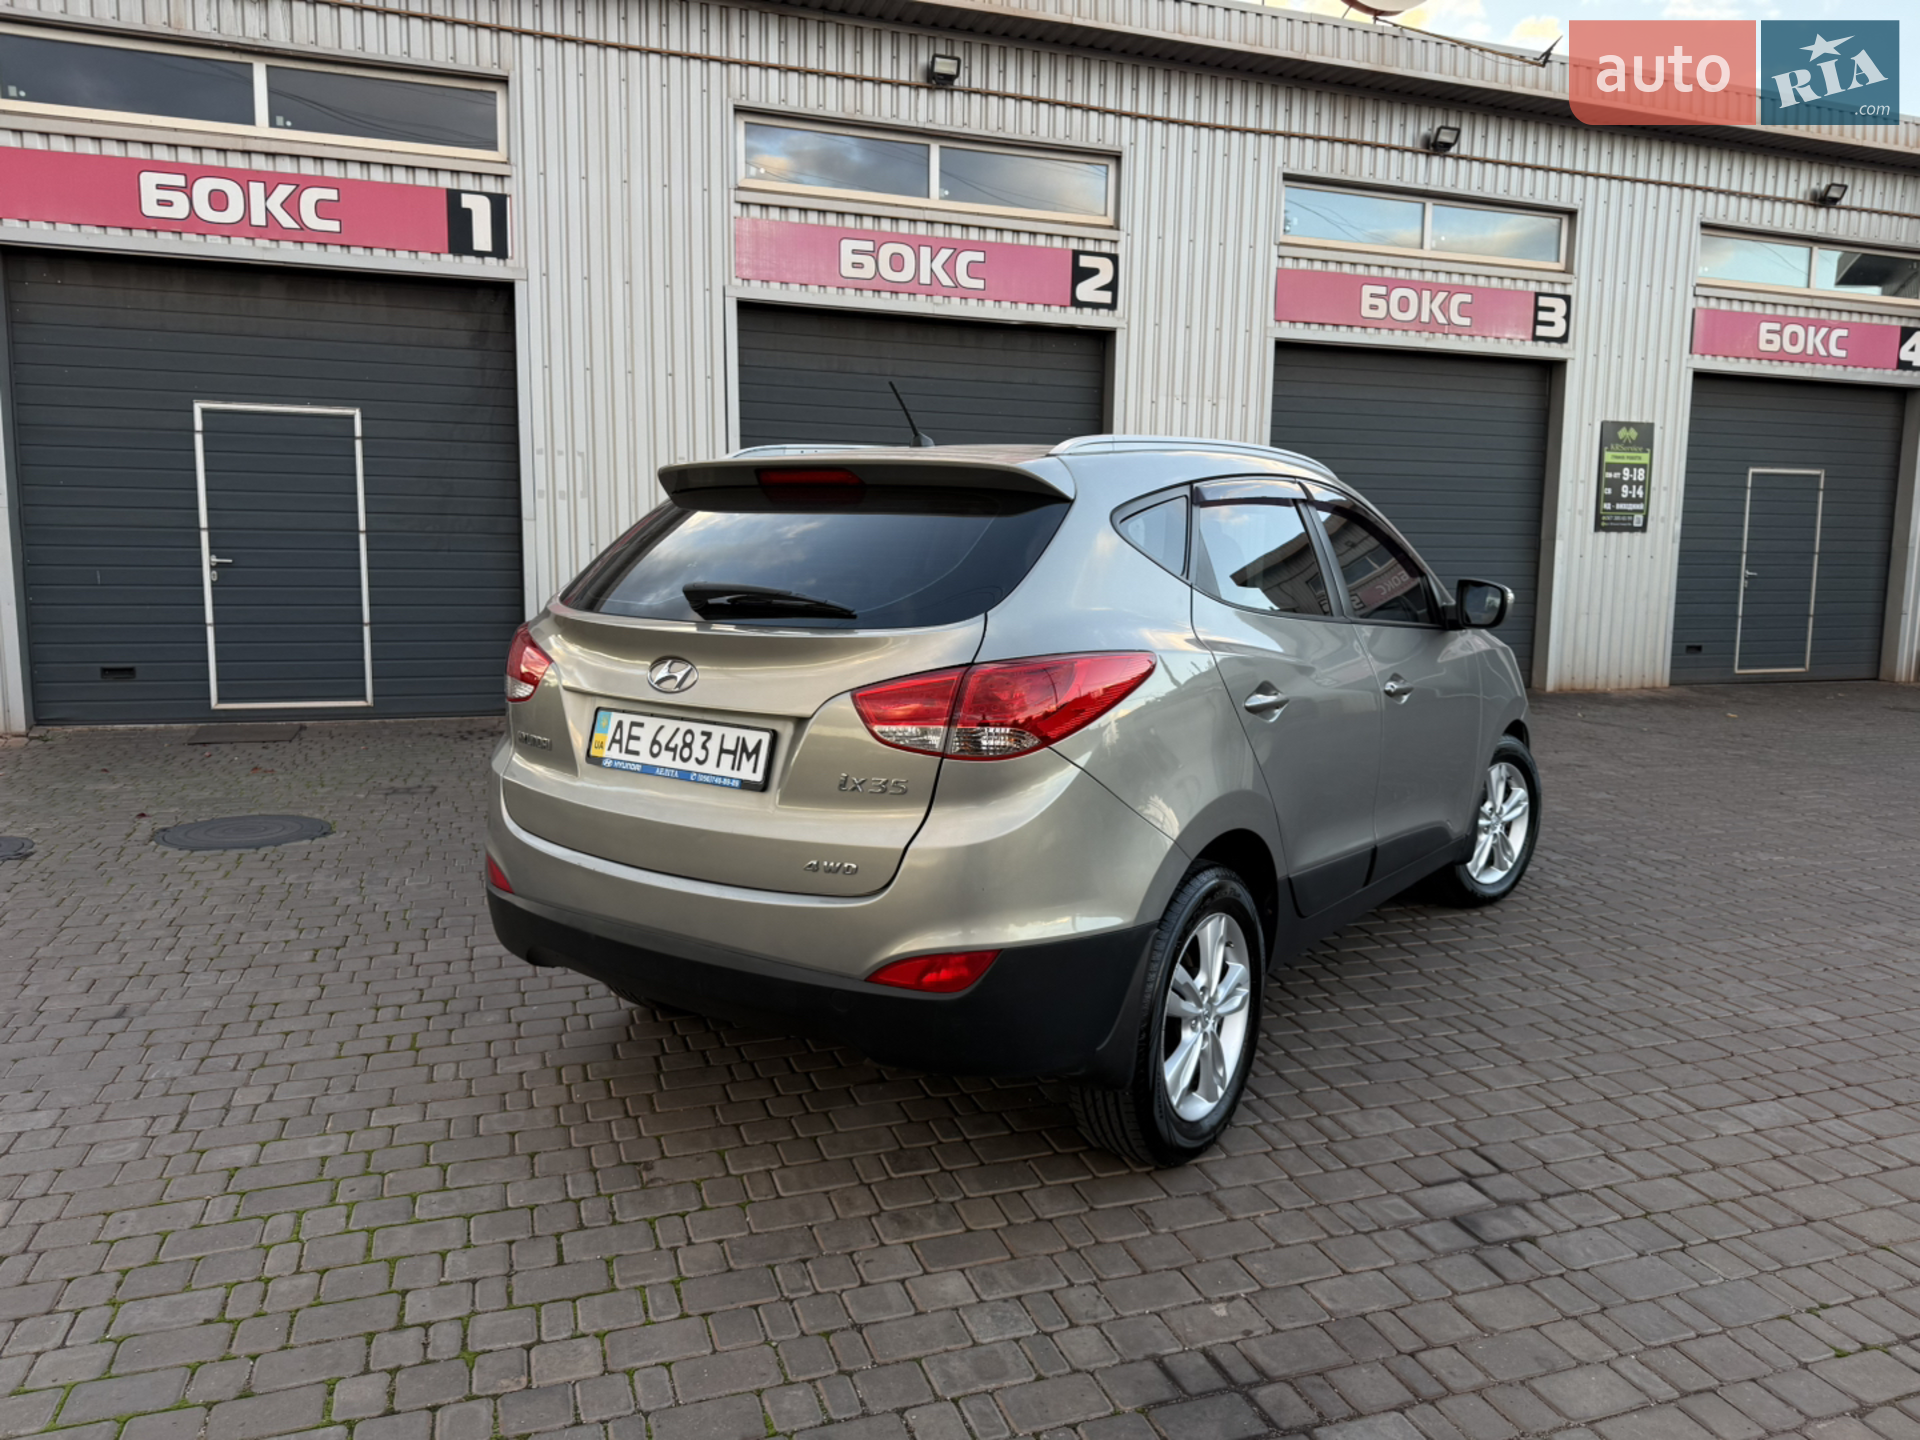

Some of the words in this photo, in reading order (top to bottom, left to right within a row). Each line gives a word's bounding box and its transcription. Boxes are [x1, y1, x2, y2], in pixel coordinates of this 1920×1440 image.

[138, 170, 342, 234] БОКС
[460, 192, 493, 252] 1
[838, 237, 986, 291] БОКС
[1075, 254, 1115, 304] 2
[1360, 283, 1473, 328] БОКС
[1535, 295, 1568, 338] 3
[1757, 320, 1850, 359] БОКС
[1898, 330, 1920, 367] 4
[1622, 467, 1645, 481] 9-18
[1620, 484, 1644, 498] 9-14
[648, 725, 713, 766] 6483
[613, 760, 642, 772] HYUNDAI
[838, 773, 909, 795] ix35
[803, 860, 859, 875] 4WD
